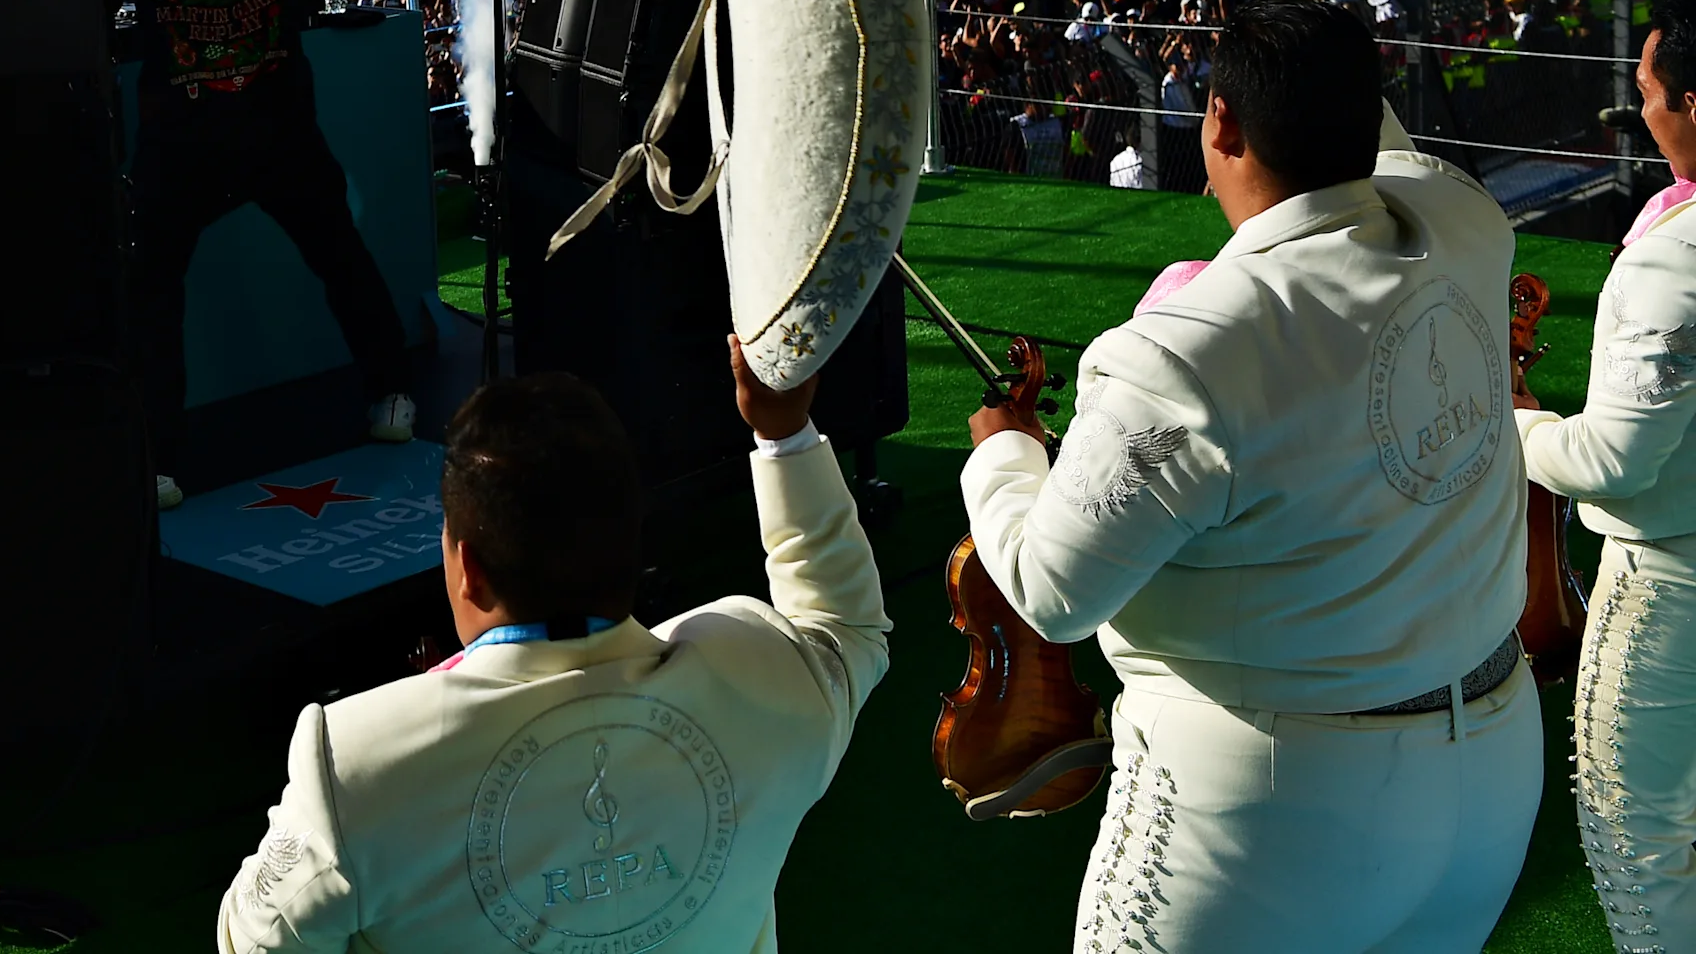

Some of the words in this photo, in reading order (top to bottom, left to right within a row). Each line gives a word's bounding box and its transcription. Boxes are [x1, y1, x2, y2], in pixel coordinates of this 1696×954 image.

[156, 5, 229, 24] MARTIN
[189, 9, 263, 43] REPLAY
[1416, 393, 1489, 460] REPA
[217, 494, 444, 574] Heinek
[542, 843, 685, 907] REPA
[684, 895, 698, 909] e
